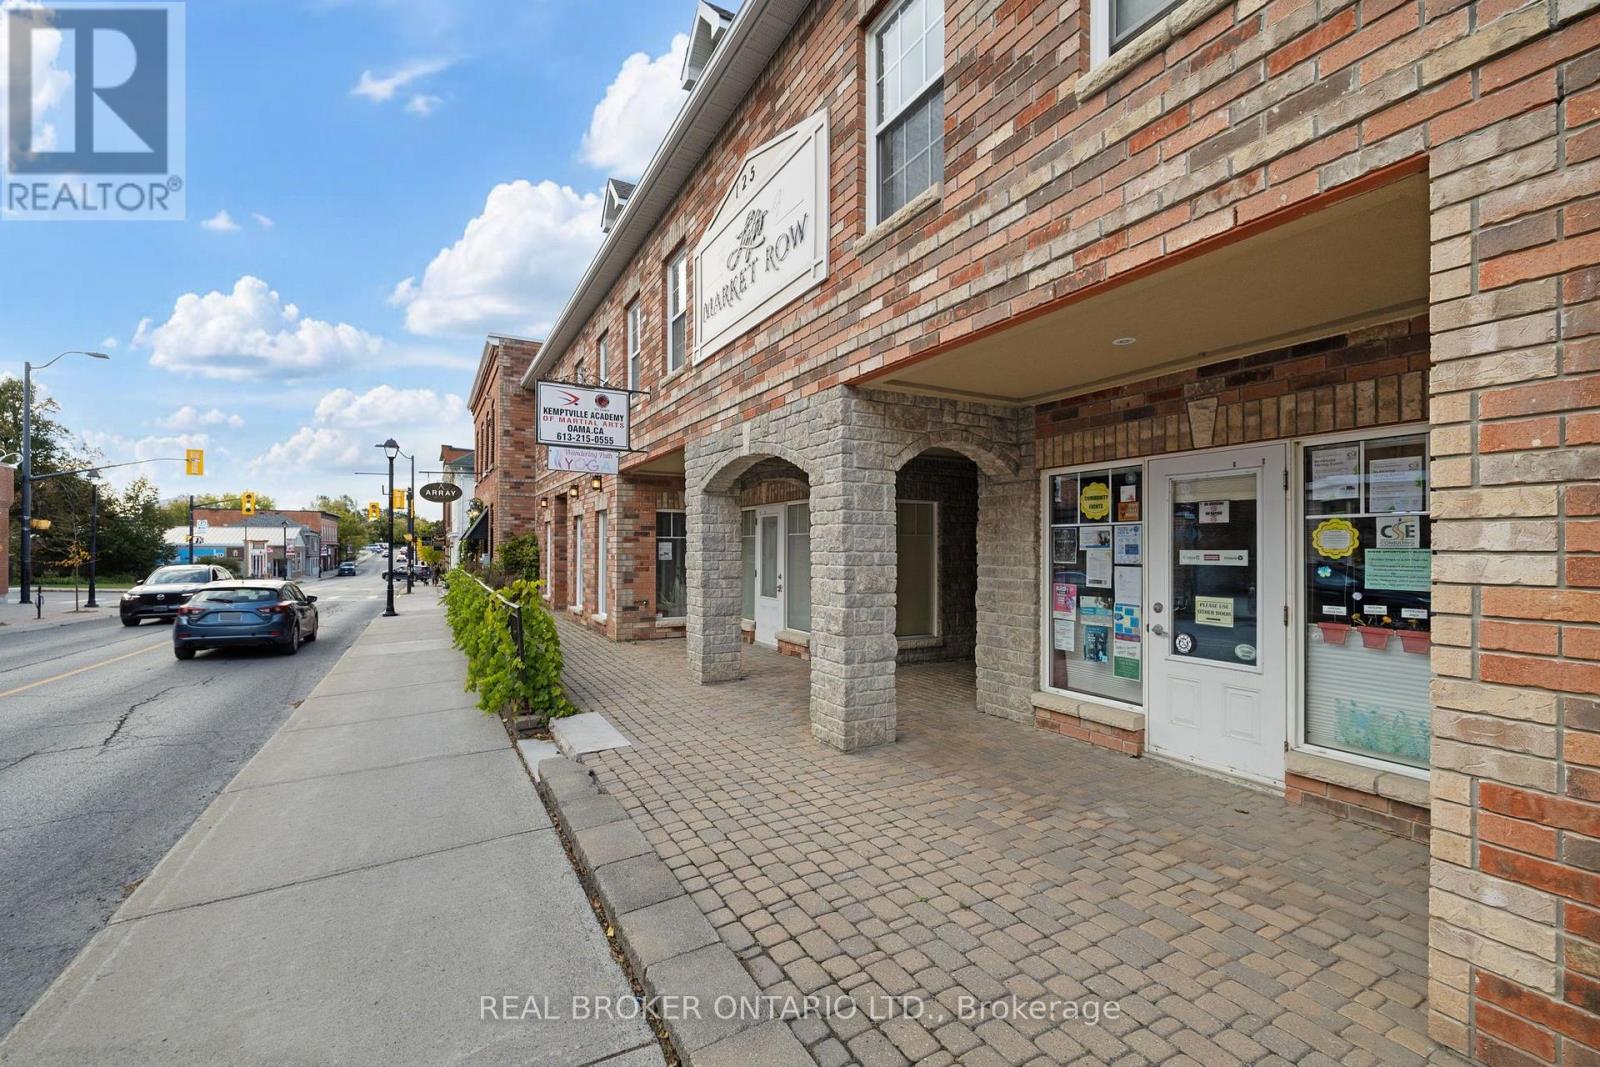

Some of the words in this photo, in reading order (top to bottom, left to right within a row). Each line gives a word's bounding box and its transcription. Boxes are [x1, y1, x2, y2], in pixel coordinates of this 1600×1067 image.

[736, 165, 755, 199] 125
[703, 257, 758, 323] MARKET
[765, 213, 808, 272] ROW
[543, 406, 588, 418] KEMPTVILLE
[590, 412, 624, 422] ACADEMY
[559, 416, 597, 426] MARTIAL
[568, 425, 604, 435] OAMA.CA
[556, 432, 614, 445] 613-215-0555
[564, 457, 612, 471] YOGA
[1380, 522, 1415, 540] CSE
